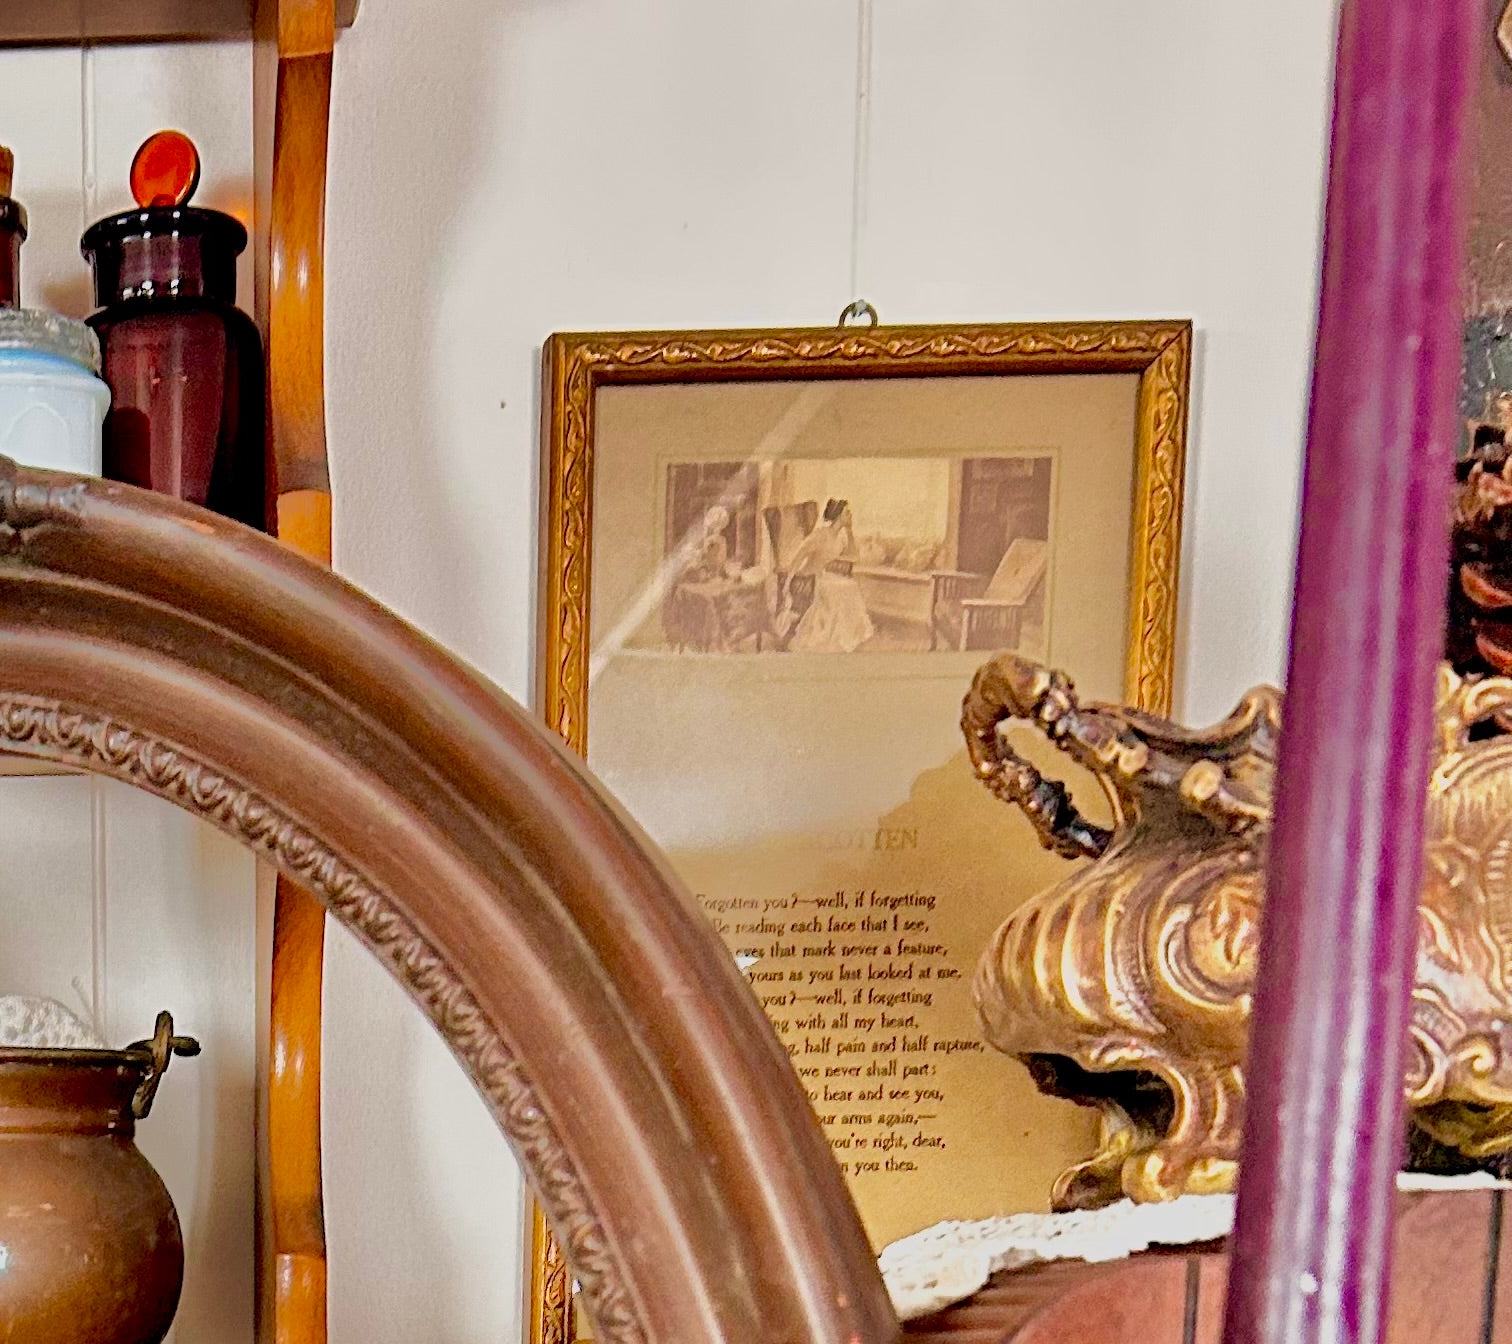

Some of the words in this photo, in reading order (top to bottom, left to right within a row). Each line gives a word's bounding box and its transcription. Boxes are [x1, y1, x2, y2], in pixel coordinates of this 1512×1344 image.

[855, 890, 865, 907] if
[870, 889, 936, 912] forgetting
[735, 917, 786, 937] reading
[790, 915, 822, 933] each
[827, 915, 855, 933] face
[861, 915, 887, 932] that
[893, 914, 898, 932] I
[903, 919, 929, 933] see,
[770, 941, 796, 958] that
[802, 939, 836, 957] mark
[841, 946, 878, 957] never
[883, 945, 891, 956] a
[897, 938, 949, 957] feature,
[749, 970, 784, 984] yours
[789, 971, 803, 981] as
[809, 971, 833, 984] you
[839, 964, 862, 981] last
[868, 961, 913, 981] looked
[919, 968, 931, 980] at
[853, 988, 863, 1005] if
[868, 987, 933, 1007] forgetting
[795, 1012, 826, 1029] with
[831, 1012, 848, 1029] all
[854, 1016, 875, 1032] my
[804, 1036, 831, 1054] half
[837, 1036, 866, 1056] pain
[871, 1035, 896, 1053] and
[902, 1034, 928, 1053] half
[933, 1038, 985, 1054] rapture,
[799, 1067, 820, 1077] we
[825, 1066, 862, 1077] never
[866, 1059, 897, 1077] shall
[824, 1085, 853, 1102] hear
[858, 1083, 884, 1101] and
[889, 1089, 910, 1100] see
[914, 1089, 944, 1104] you,
[841, 1113, 872, 1125] arms
[873, 1132, 908, 1152] right,
[912, 1131, 946, 1149] dear,
[854, 1160, 879, 1176] you
